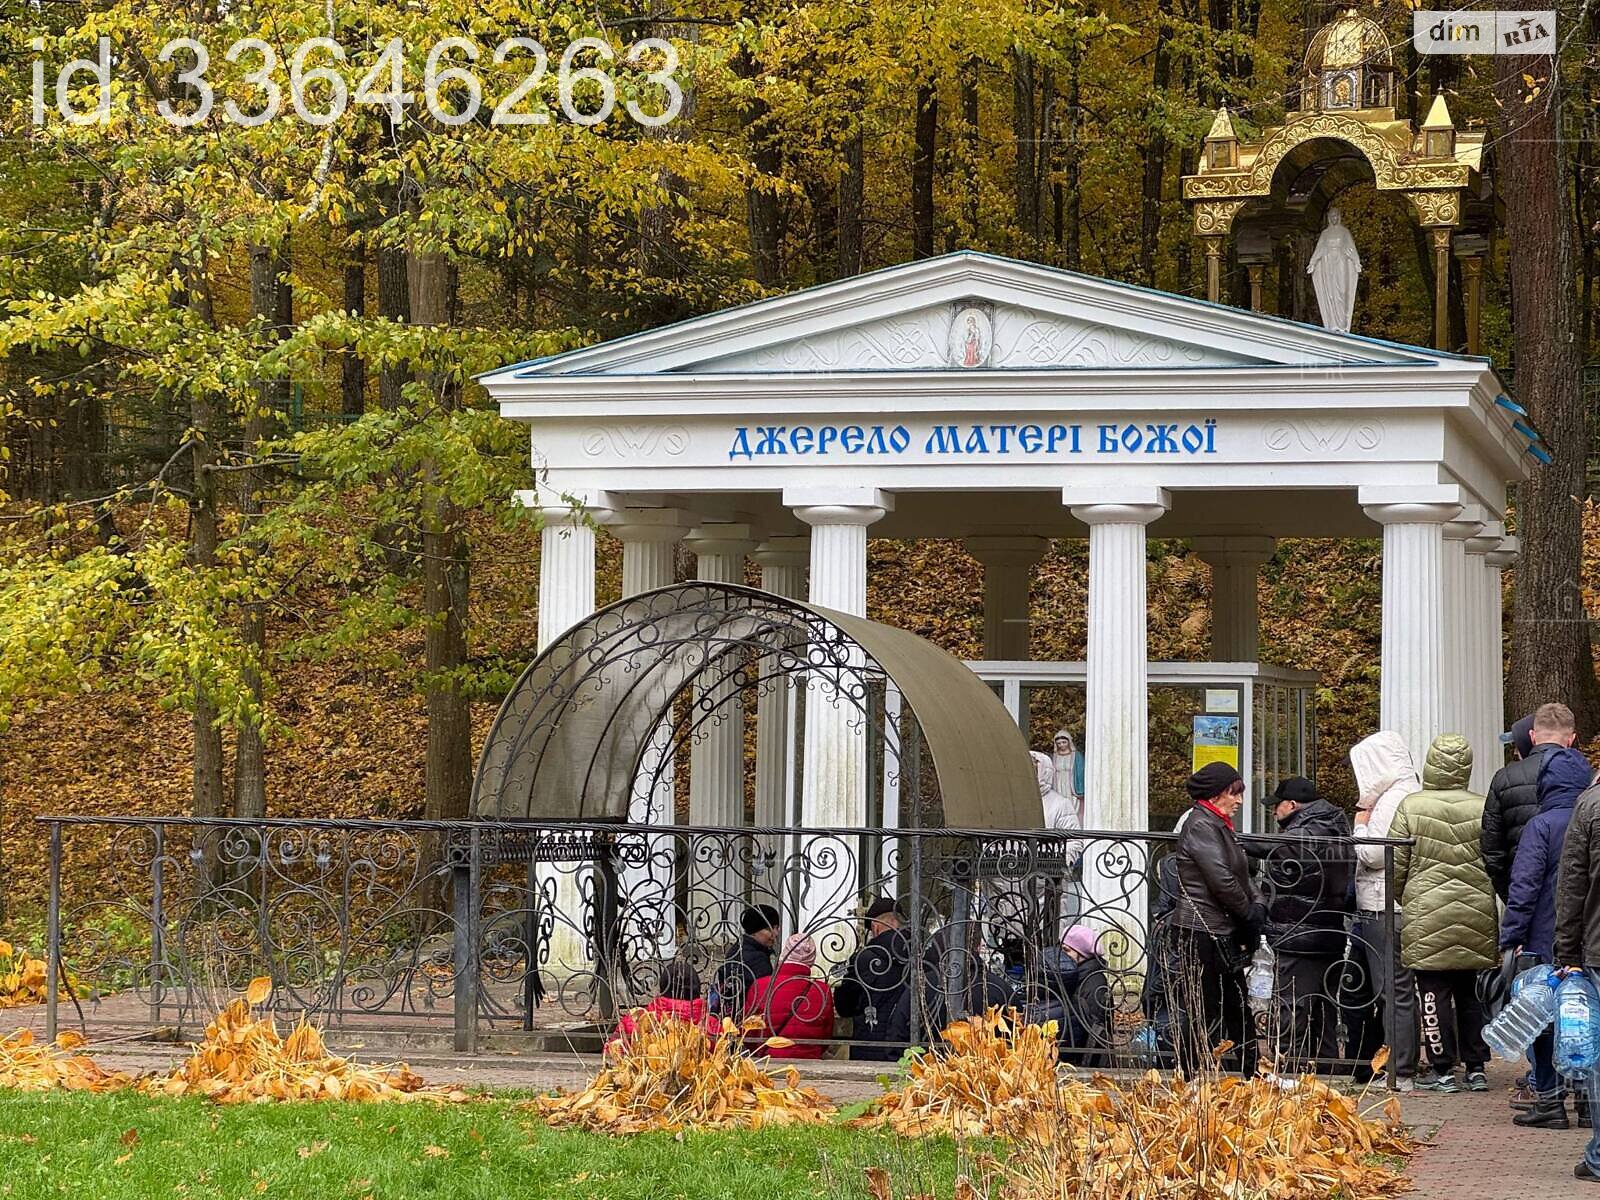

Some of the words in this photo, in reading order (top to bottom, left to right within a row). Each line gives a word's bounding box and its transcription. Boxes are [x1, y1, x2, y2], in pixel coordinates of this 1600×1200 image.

[729, 425, 911, 461] ДЖЕРЕЛО
[925, 424, 1082, 455] МАТЕРІ
[1097, 418, 1218, 455] БОЖОЇ
[1423, 991, 1444, 1056] adidas
